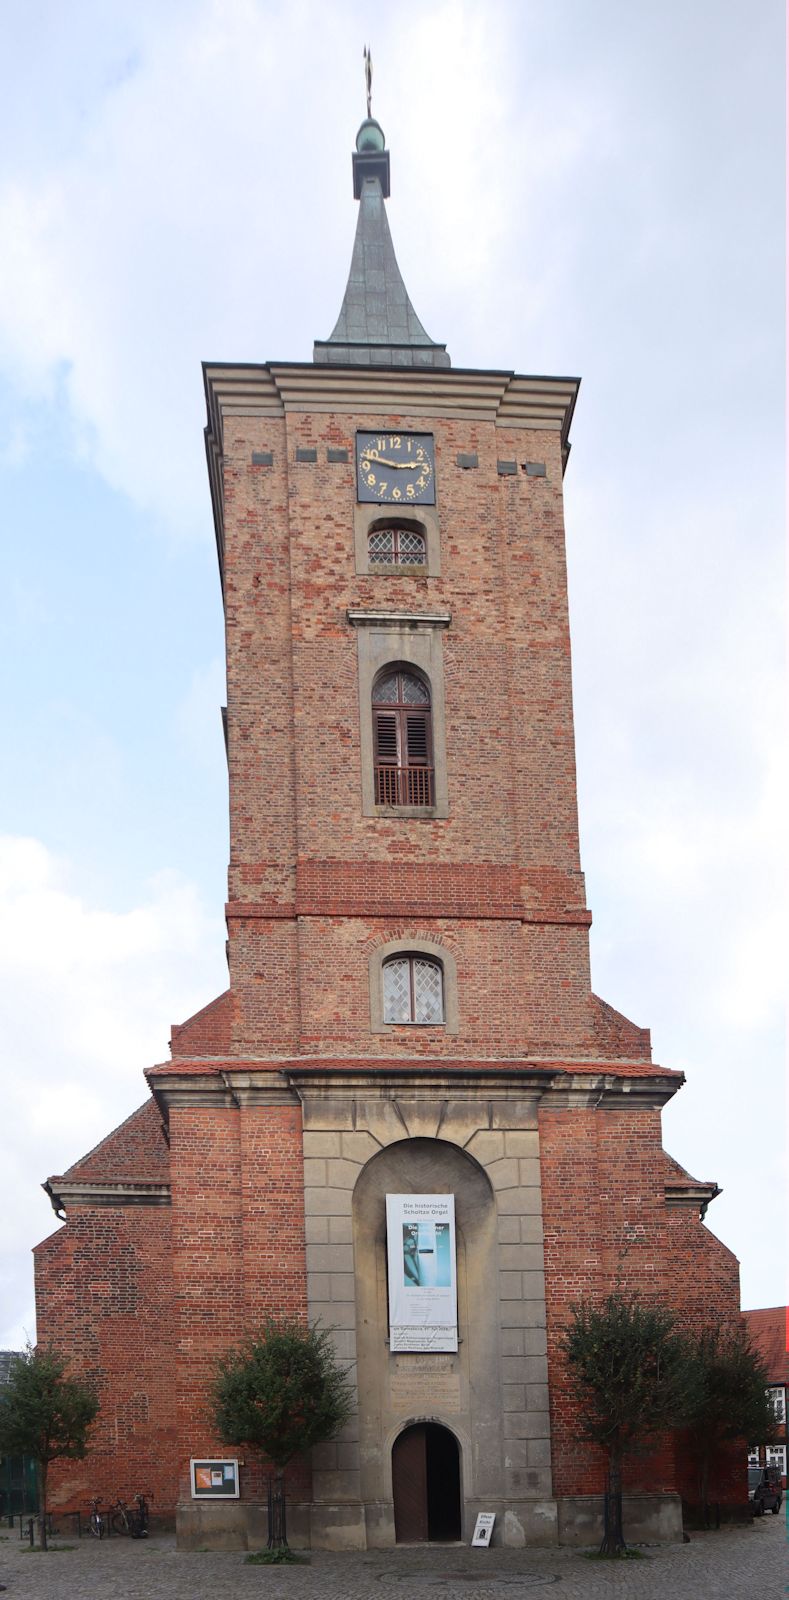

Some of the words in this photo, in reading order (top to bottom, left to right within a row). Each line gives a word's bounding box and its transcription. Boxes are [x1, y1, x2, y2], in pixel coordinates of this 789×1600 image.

[377, 439, 386, 451] 11
[390, 437, 401, 448] 12
[407, 440, 411, 452] 1
[366, 448, 379, 460] 10
[416, 449, 424, 461] 2
[362, 460, 371, 473] 9
[422, 463, 430, 475] 3
[367, 473, 376, 486] 8
[416, 475, 426, 487] 4
[379, 482, 388, 495] 7
[392, 486, 401, 498] 6
[406, 484, 415, 496] 5
